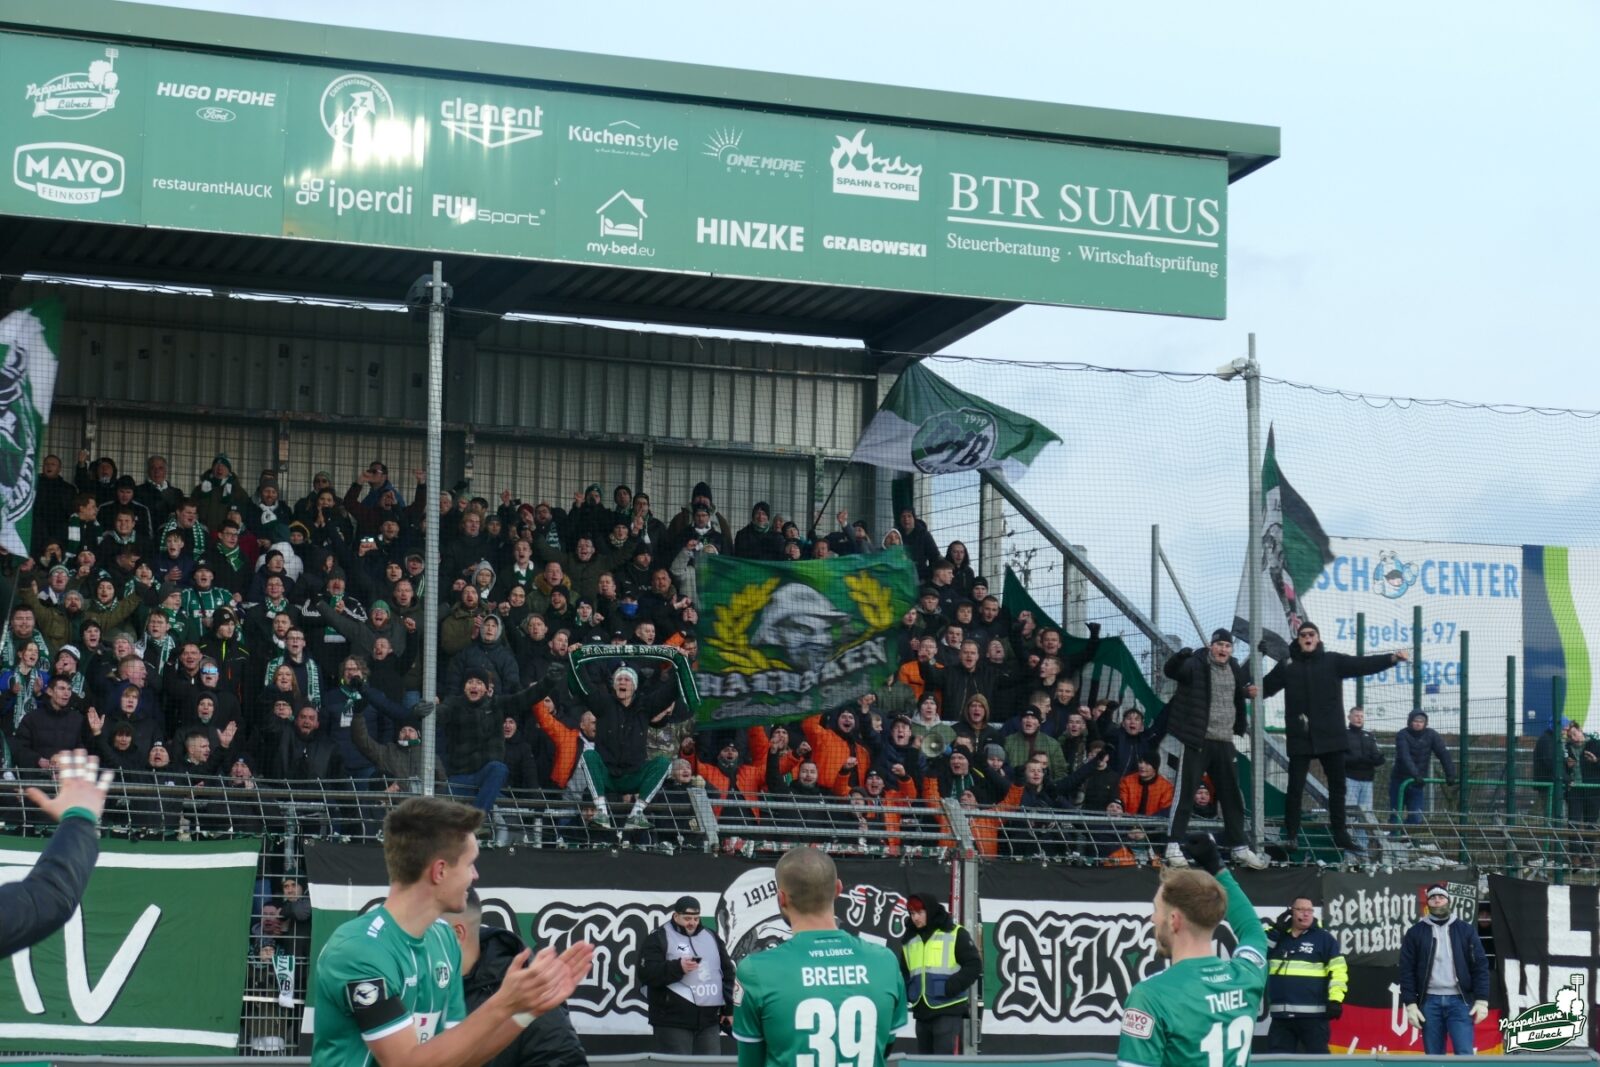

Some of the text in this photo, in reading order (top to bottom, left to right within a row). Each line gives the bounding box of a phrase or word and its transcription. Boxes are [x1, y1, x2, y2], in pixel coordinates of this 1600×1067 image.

[57, 98, 93, 109] Lübeck
[156, 81, 277, 107] HUGO PFOHE
[203, 109, 229, 120] Ford
[441, 97, 543, 127] clement
[568, 125, 679, 153] Küchenstyle
[25, 153, 115, 185] MAYO
[726, 153, 806, 173] ONE MORE
[41, 187, 96, 201] FEINKOST
[152, 177, 273, 198] restaurantHAUCK
[328, 179, 413, 216] iperdi
[836, 176, 918, 193] SPAHN & TOPEL
[948, 172, 1221, 237] BTR SUMUS
[696, 217, 805, 253] HINZKE
[822, 234, 928, 258] GRABOWSKI
[586, 240, 656, 257] my-bed.eu
[946, 232, 1220, 278] Steuerberatung Wirtschaftsprüfung
[1420, 560, 1520, 598] CENTER
[743, 880, 778, 908] 1919
[1328, 886, 1417, 937] sektion
[1329, 920, 1403, 956] eusta
[808, 947, 855, 958] VFB LÜBECK
[801, 965, 870, 988] BREIER
[1205, 989, 1248, 1014] THIEL
[794, 995, 878, 1067] 39
[1126, 1012, 1148, 1025] MAYO
